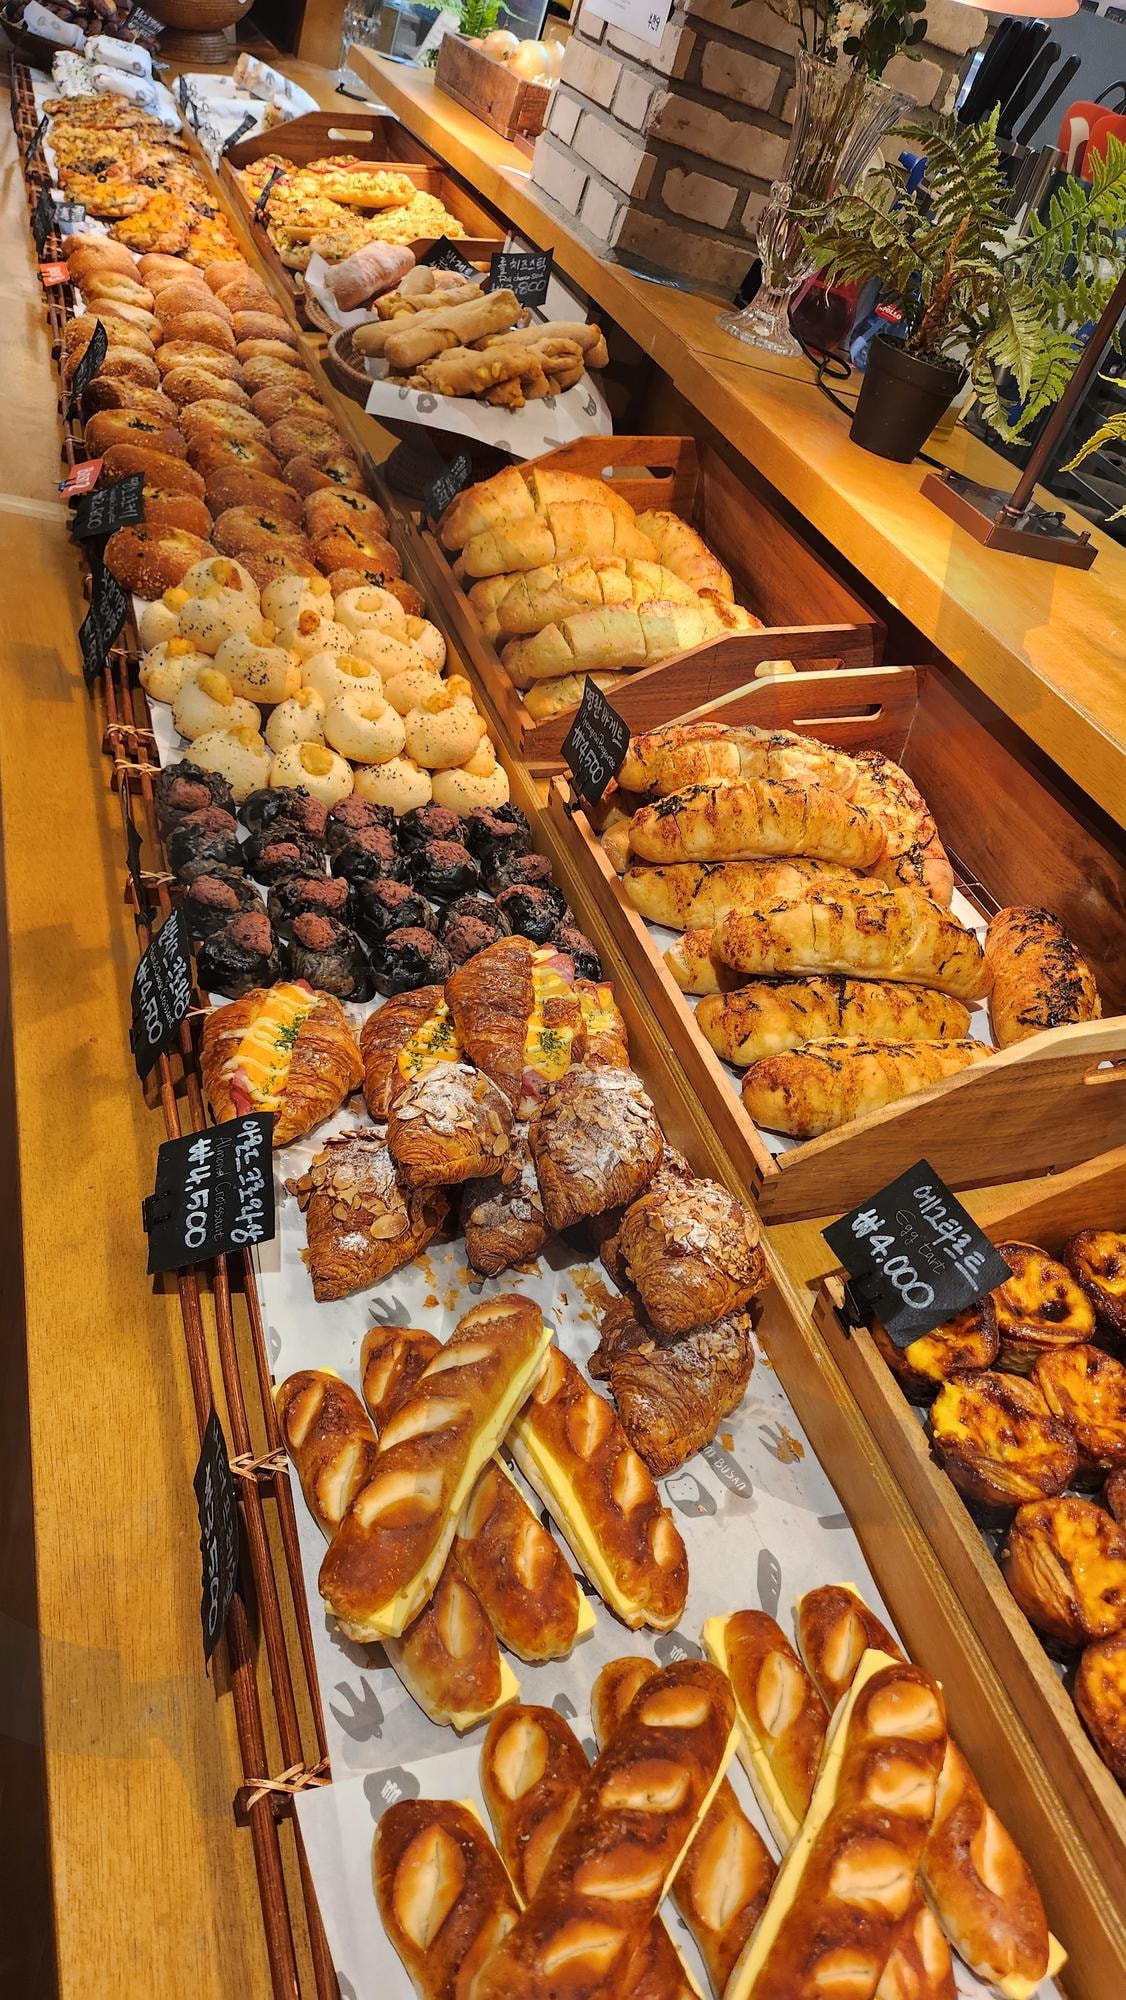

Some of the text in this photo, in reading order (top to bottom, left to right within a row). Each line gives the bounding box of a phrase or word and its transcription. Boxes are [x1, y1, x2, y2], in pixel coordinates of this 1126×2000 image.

[509, 257, 547, 272] 치즈스틱
[213, 1137, 233, 1242] Almond Croissant
[230, 1119, 266, 1244] 아몬드 크로와상
[895, 1209, 947, 1275] Egg tart
[912, 1185, 987, 1293] 에그타르트
[713, 1457, 747, 1491] BUSAN
